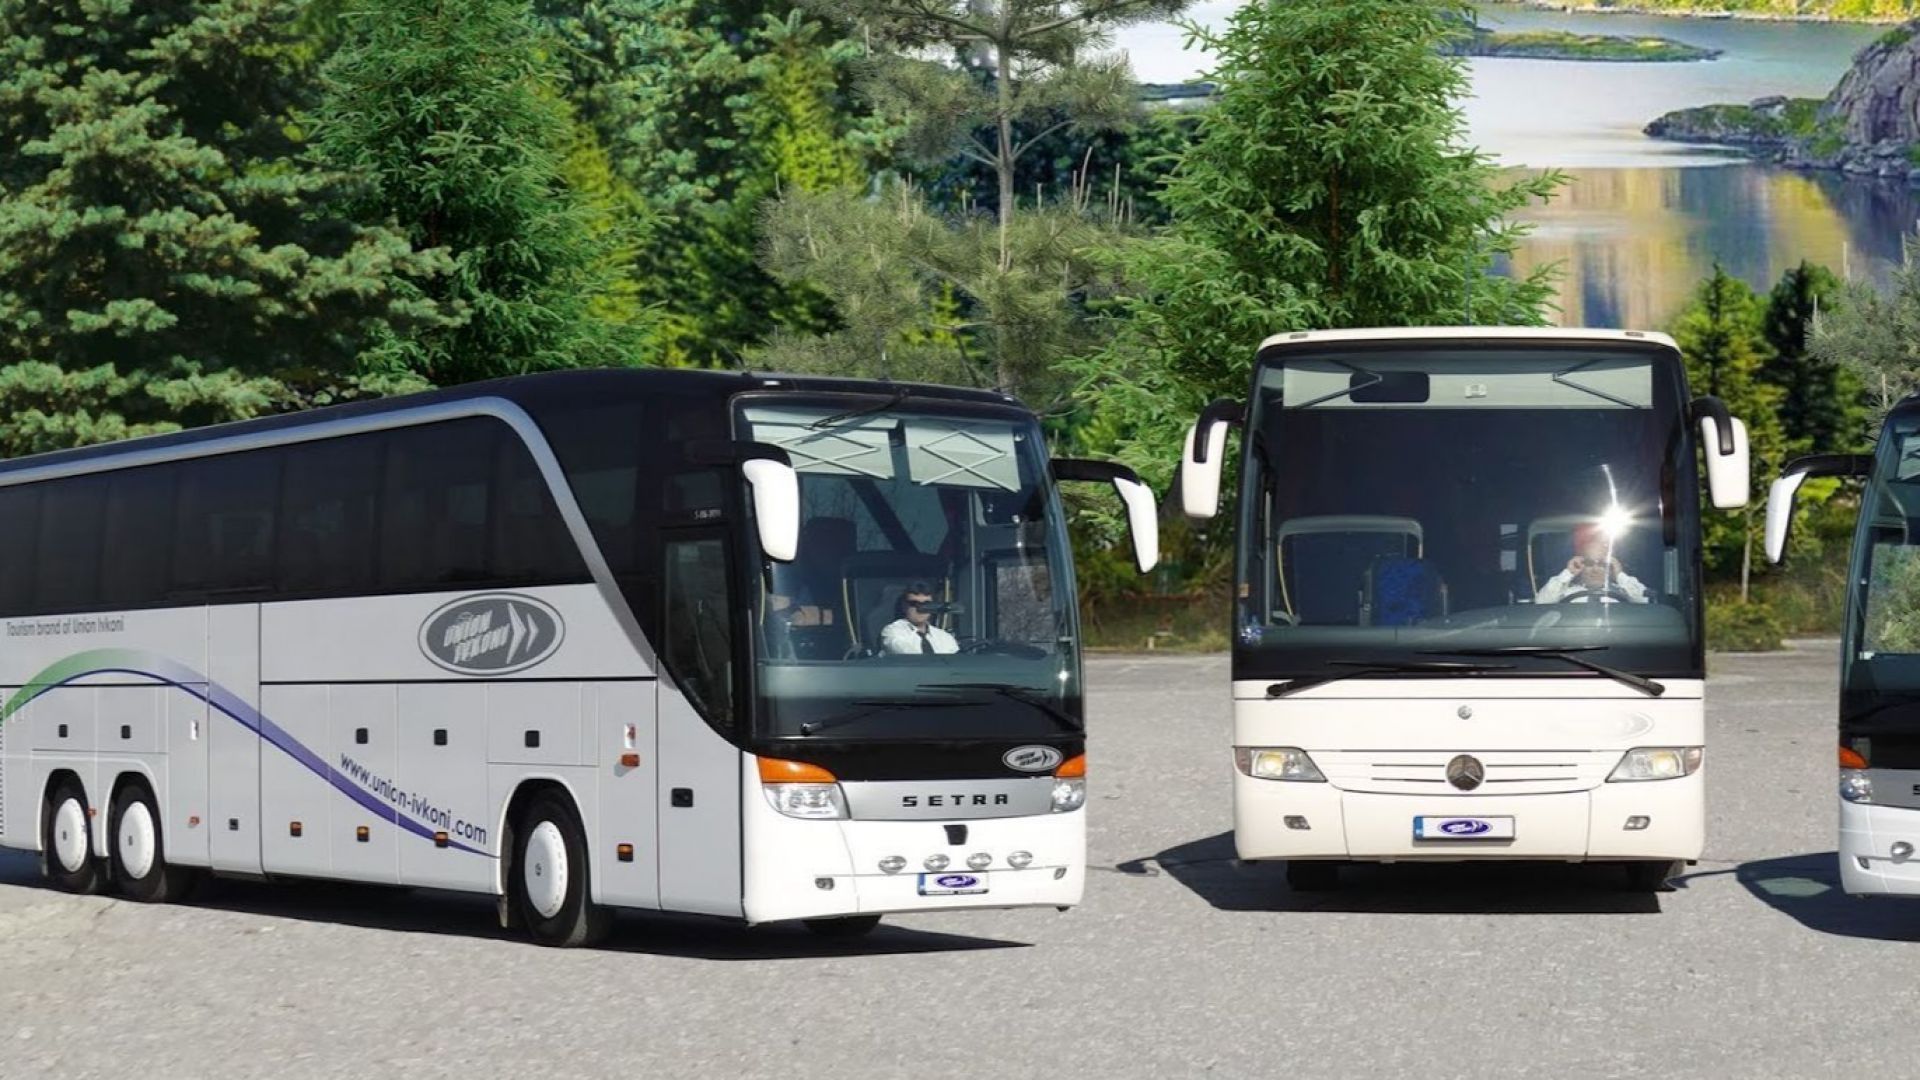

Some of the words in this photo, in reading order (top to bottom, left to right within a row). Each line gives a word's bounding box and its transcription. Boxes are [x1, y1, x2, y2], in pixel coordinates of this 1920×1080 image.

[6, 621, 35, 636] Tourism
[37, 619, 61, 635] brand
[62, 617, 71, 634] of
[72, 617, 97, 633] Union
[340, 753, 487, 845] www.union-ivkoni.com
[902, 793, 1008, 807] SETRA
